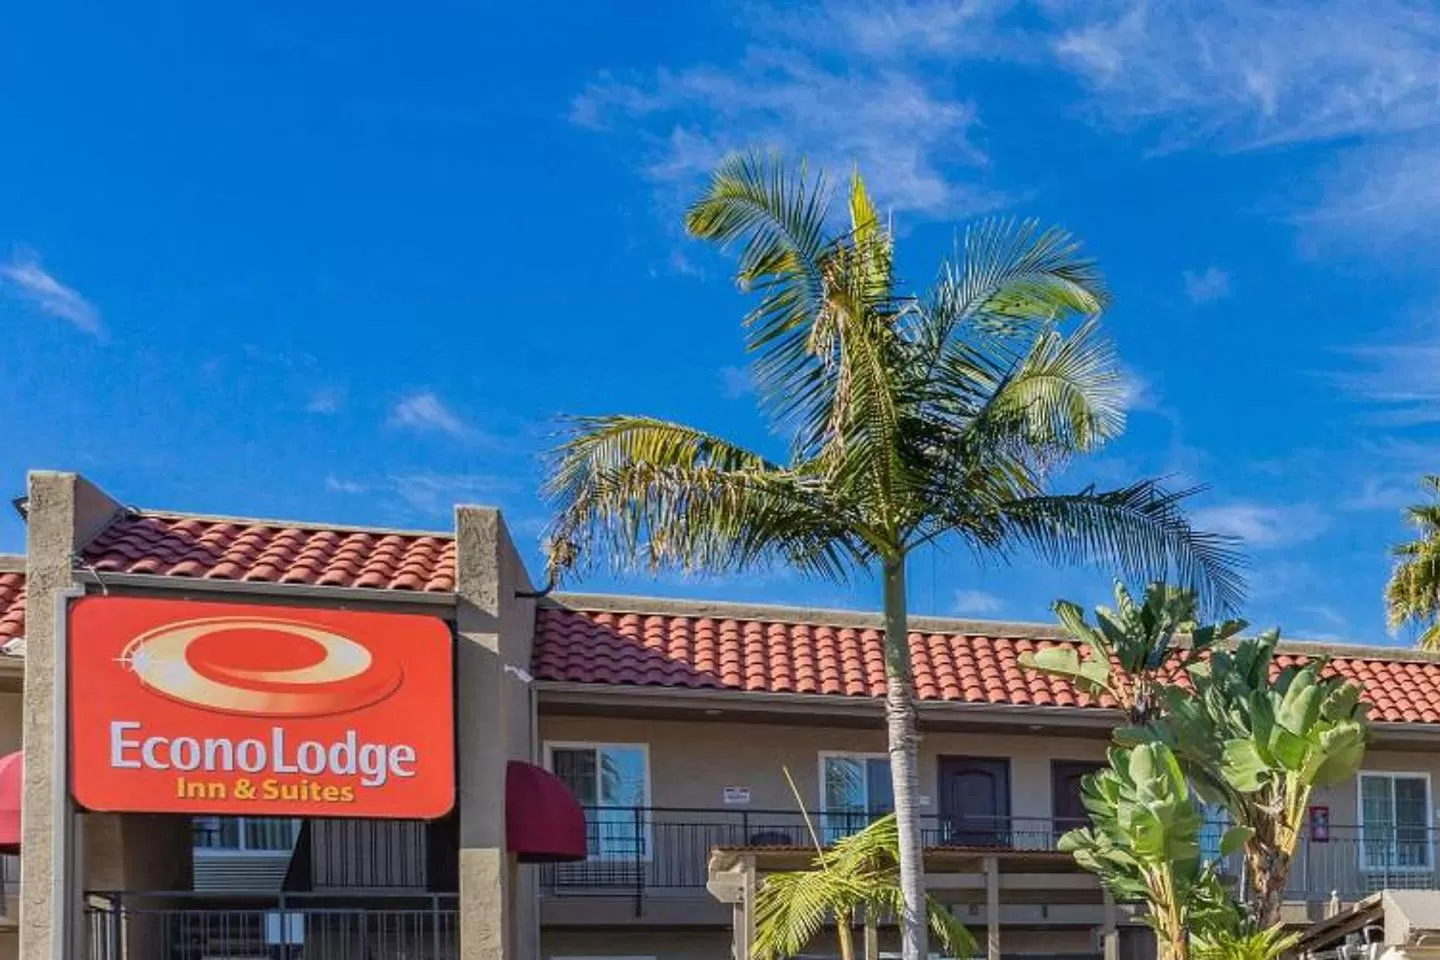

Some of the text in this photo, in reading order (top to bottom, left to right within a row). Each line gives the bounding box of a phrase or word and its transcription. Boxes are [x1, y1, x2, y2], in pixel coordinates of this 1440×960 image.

[110, 721, 416, 786] EconoLodge
[177, 777, 354, 802] Inn & Suites
